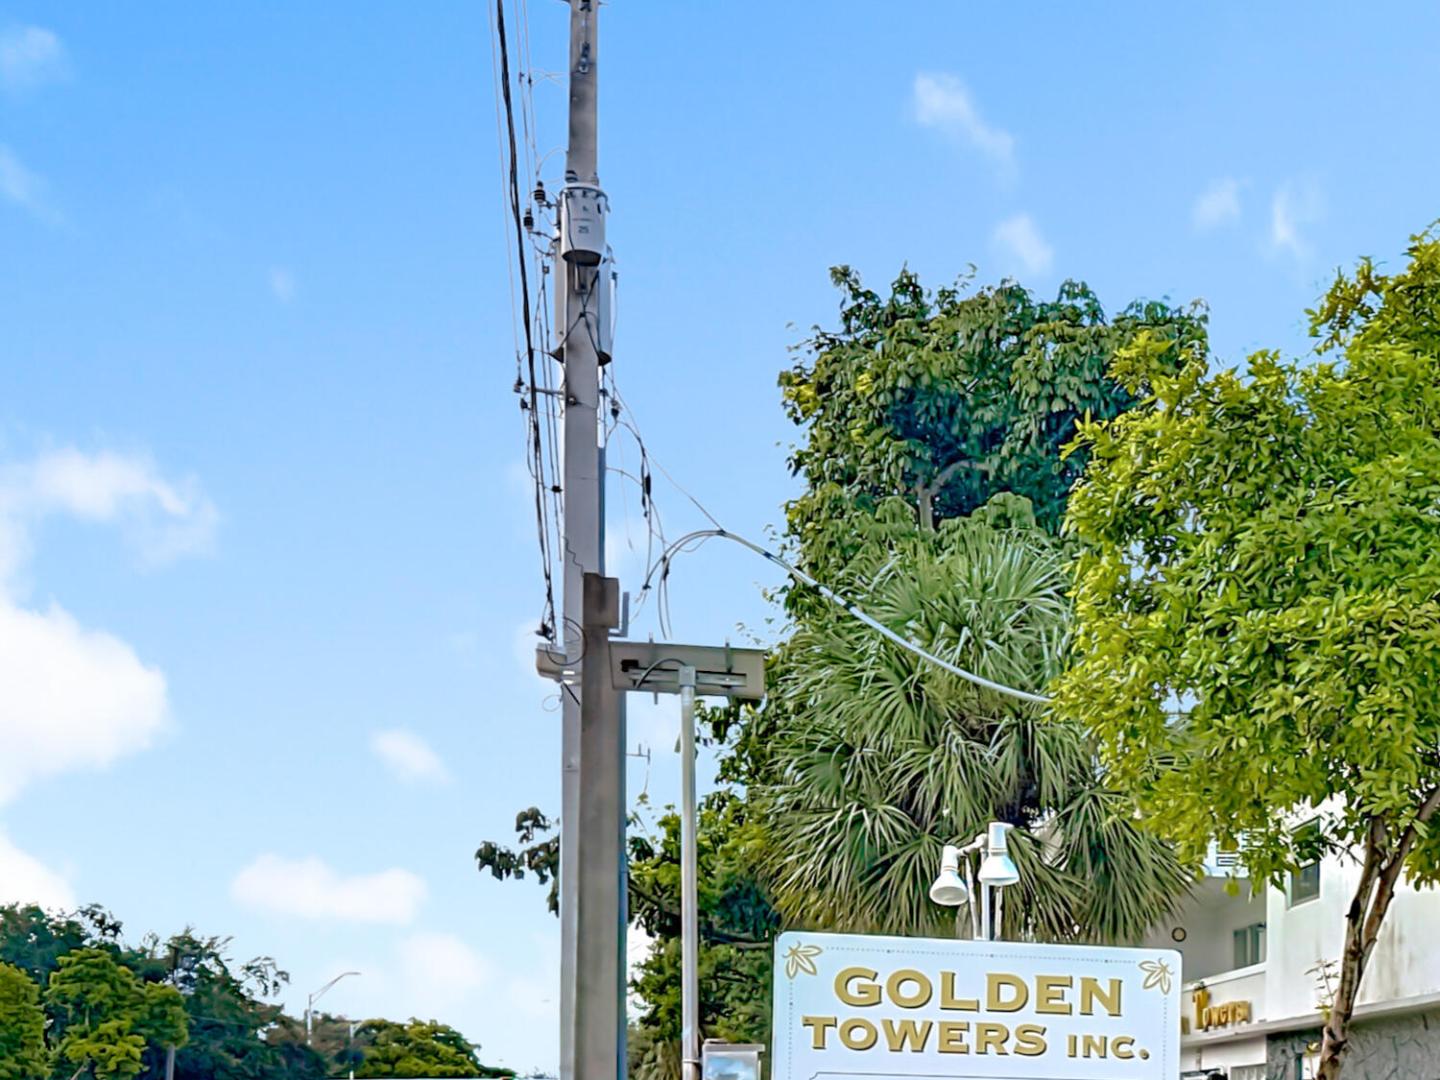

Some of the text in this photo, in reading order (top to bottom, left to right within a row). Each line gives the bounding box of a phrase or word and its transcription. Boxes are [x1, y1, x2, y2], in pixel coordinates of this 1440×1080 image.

[834, 967, 1123, 1017] GOLDEN
[803, 1016, 1150, 1060] TOWERS INC.
